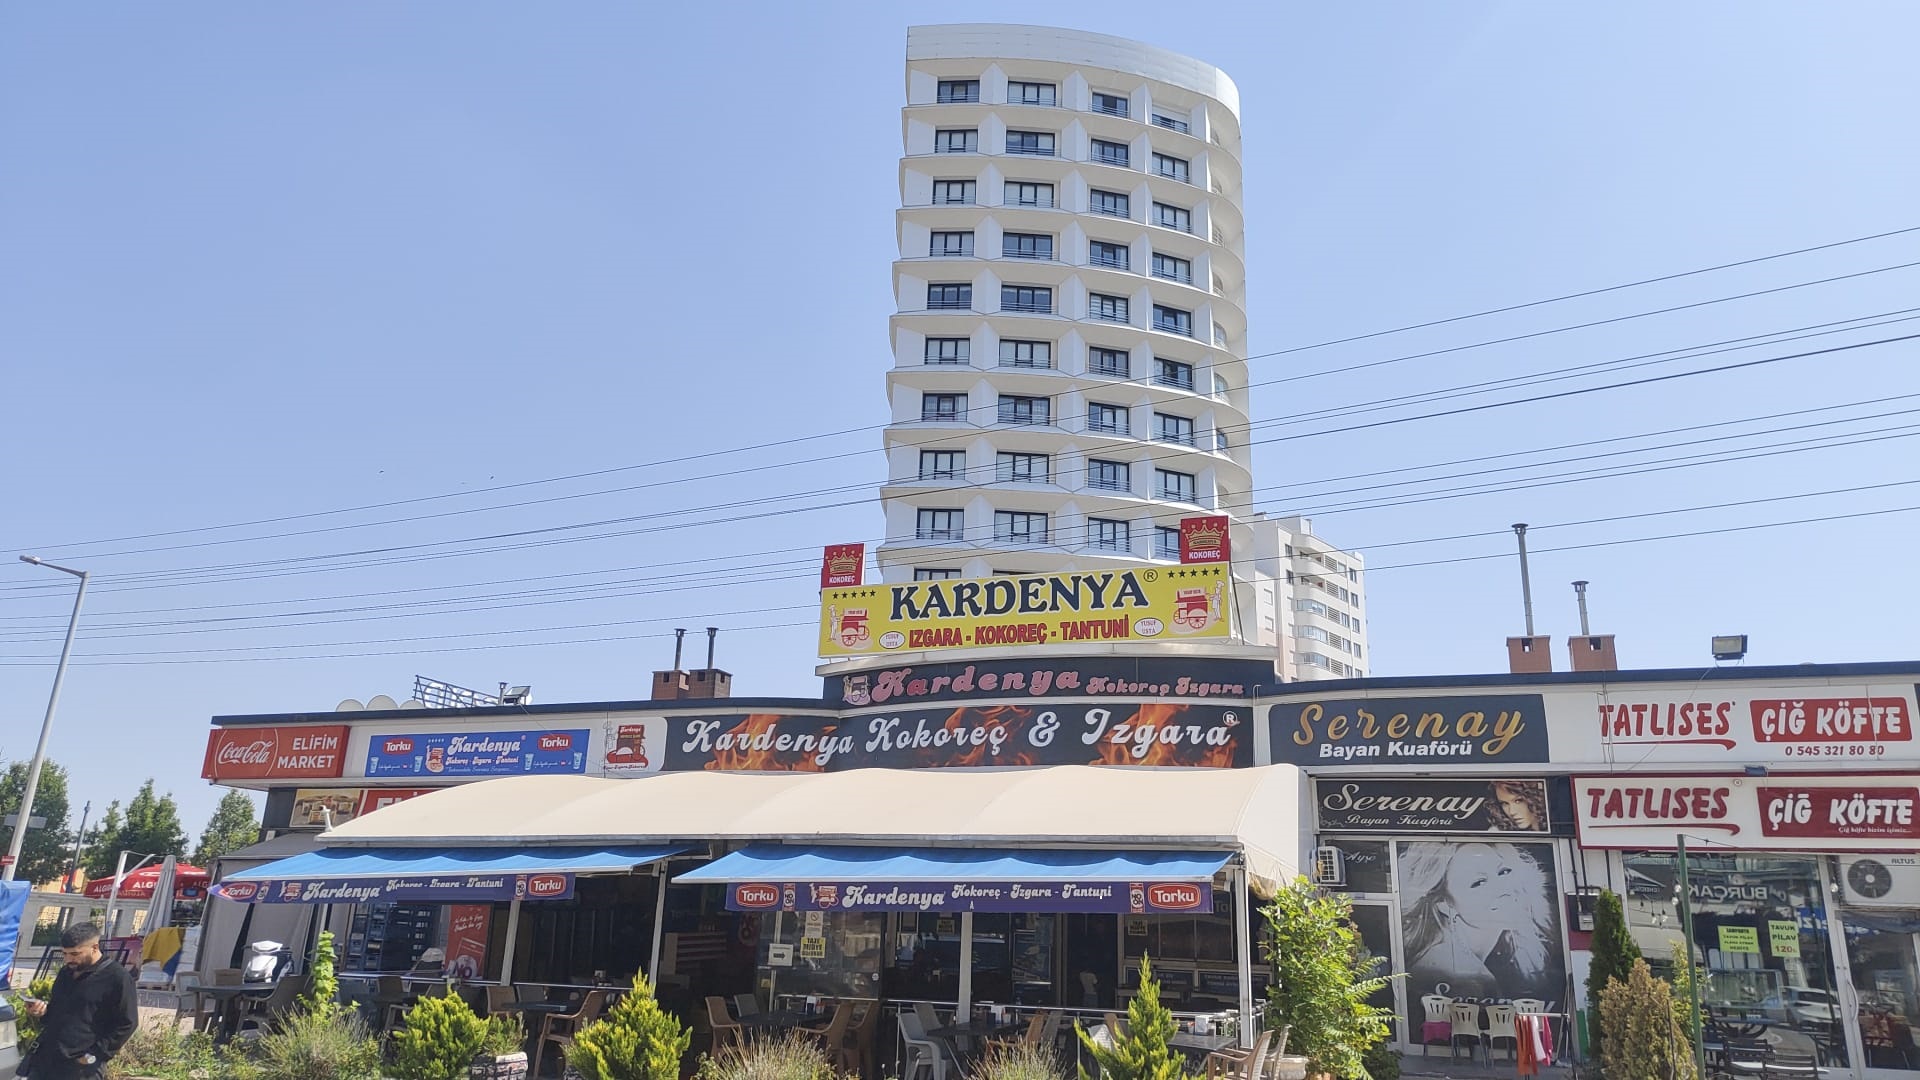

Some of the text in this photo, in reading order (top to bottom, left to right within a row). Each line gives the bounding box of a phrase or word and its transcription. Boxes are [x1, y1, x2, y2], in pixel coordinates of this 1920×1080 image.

[1188, 550, 1221, 560] KOKOREÇ
[829, 575, 856, 585] KOKOREÇ
[889, 571, 1149, 621] KARDENYA
[909, 627, 963, 648] IZGARA
[975, 623, 1048, 645] KOKOREÇ
[1059, 614, 1130, 640] TANTUNİ
[871, 665, 1245, 703] Kardenya Kokoreç Izgara
[1293, 703, 1526, 756] Serenay
[1599, 702, 1731, 737] TATLISES
[1761, 700, 1901, 742] ÇİĞ KÖFTE
[292, 734, 338, 750] ELİFİM
[385, 741, 412, 752] Torku
[447, 735, 521, 756] Kardenya
[541, 735, 569, 748] Torku
[682, 719, 855, 766] Kardenya
[865, 717, 1009, 757] Kokoreç
[1028, 711, 1061, 748] &
[1081, 708, 1232, 759] Izgara
[218, 740, 275, 765] Coca-Cola
[1319, 741, 1472, 761] Bayan Kuaförü
[1785, 745, 1885, 756] 0 545 321 80 80
[277, 755, 335, 769] MARKET
[1323, 783, 1485, 820] Serenay
[1587, 787, 1730, 819] TATLISES
[1345, 814, 1390, 827] Bayan
[1768, 793, 1913, 831] ÇİĞ KÖFTE
[226, 887, 252, 896] Torku
[302, 882, 381, 902] Kardenya
[466, 877, 504, 888] Tantuni
[533, 879, 562, 891] Torku
[741, 889, 775, 902] Torku
[842, 884, 945, 910] Kardenya
[951, 884, 1001, 900] Kokoreç
[1010, 884, 1052, 900] Izgara
[1061, 884, 1112, 899] Tantuni
[1154, 888, 1195, 903] Torku
[1772, 933, 1797, 941] PİLAV
